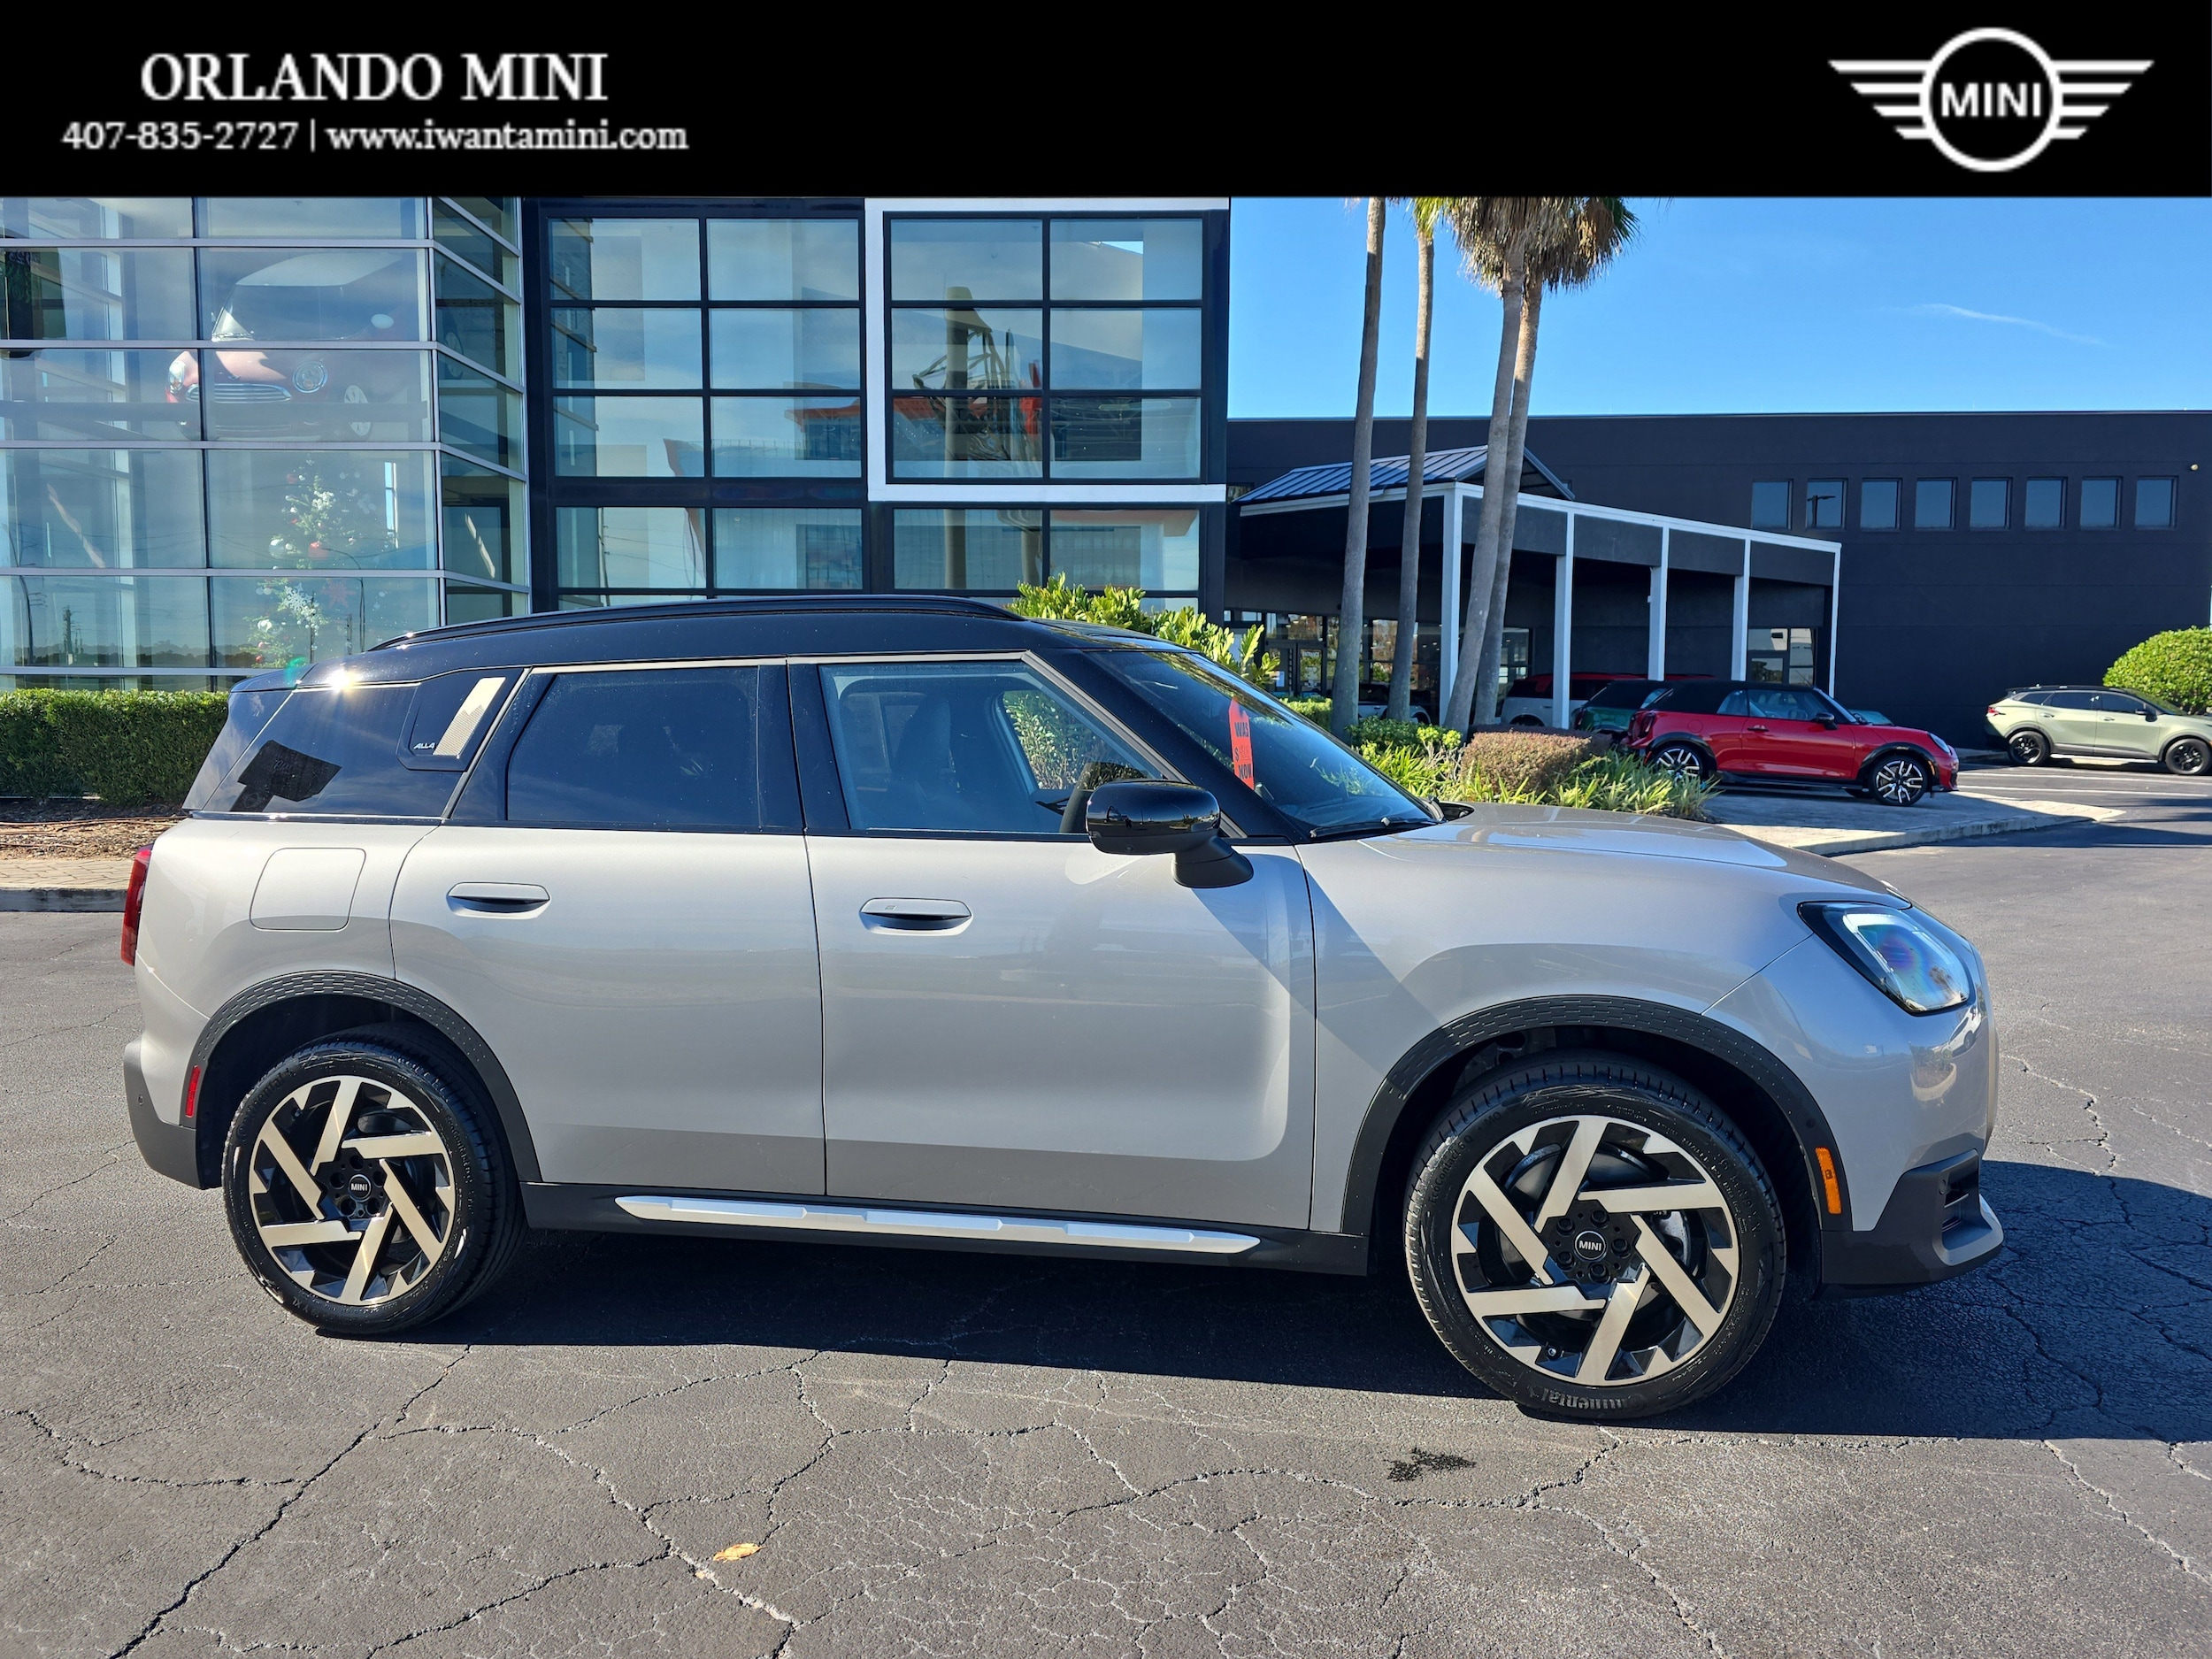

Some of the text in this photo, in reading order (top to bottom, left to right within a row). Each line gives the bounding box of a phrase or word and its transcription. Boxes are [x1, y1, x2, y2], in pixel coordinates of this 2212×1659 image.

[1234, 722, 1249, 738] WAS
[1238, 764, 1251, 779] NOW
[1578, 1240, 1602, 1252] MINI
